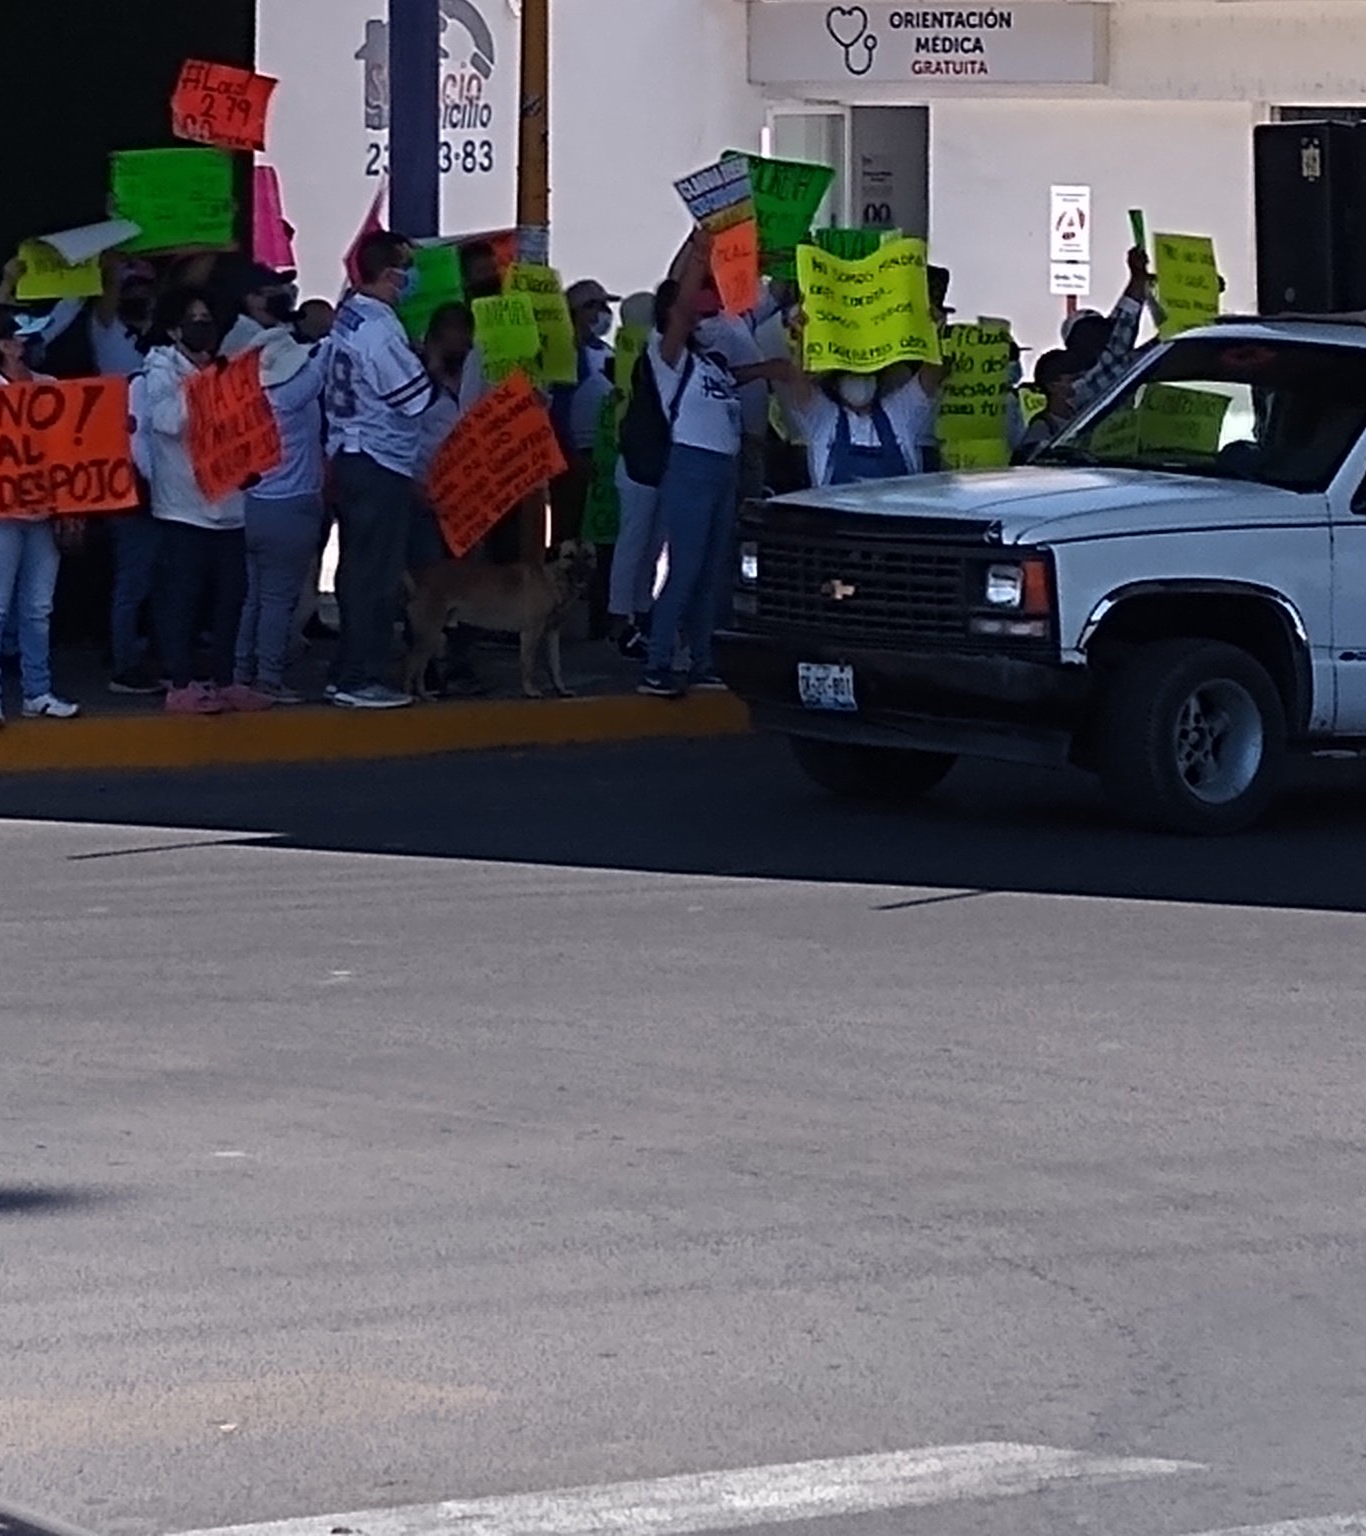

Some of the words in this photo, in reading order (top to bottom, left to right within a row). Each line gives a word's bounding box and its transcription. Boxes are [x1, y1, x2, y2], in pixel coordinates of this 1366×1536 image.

[889, 7, 1012, 29] ORIENTACIÓN
[915, 34, 984, 54] MÉDICA
[911, 60, 988, 75] GRATUITA
